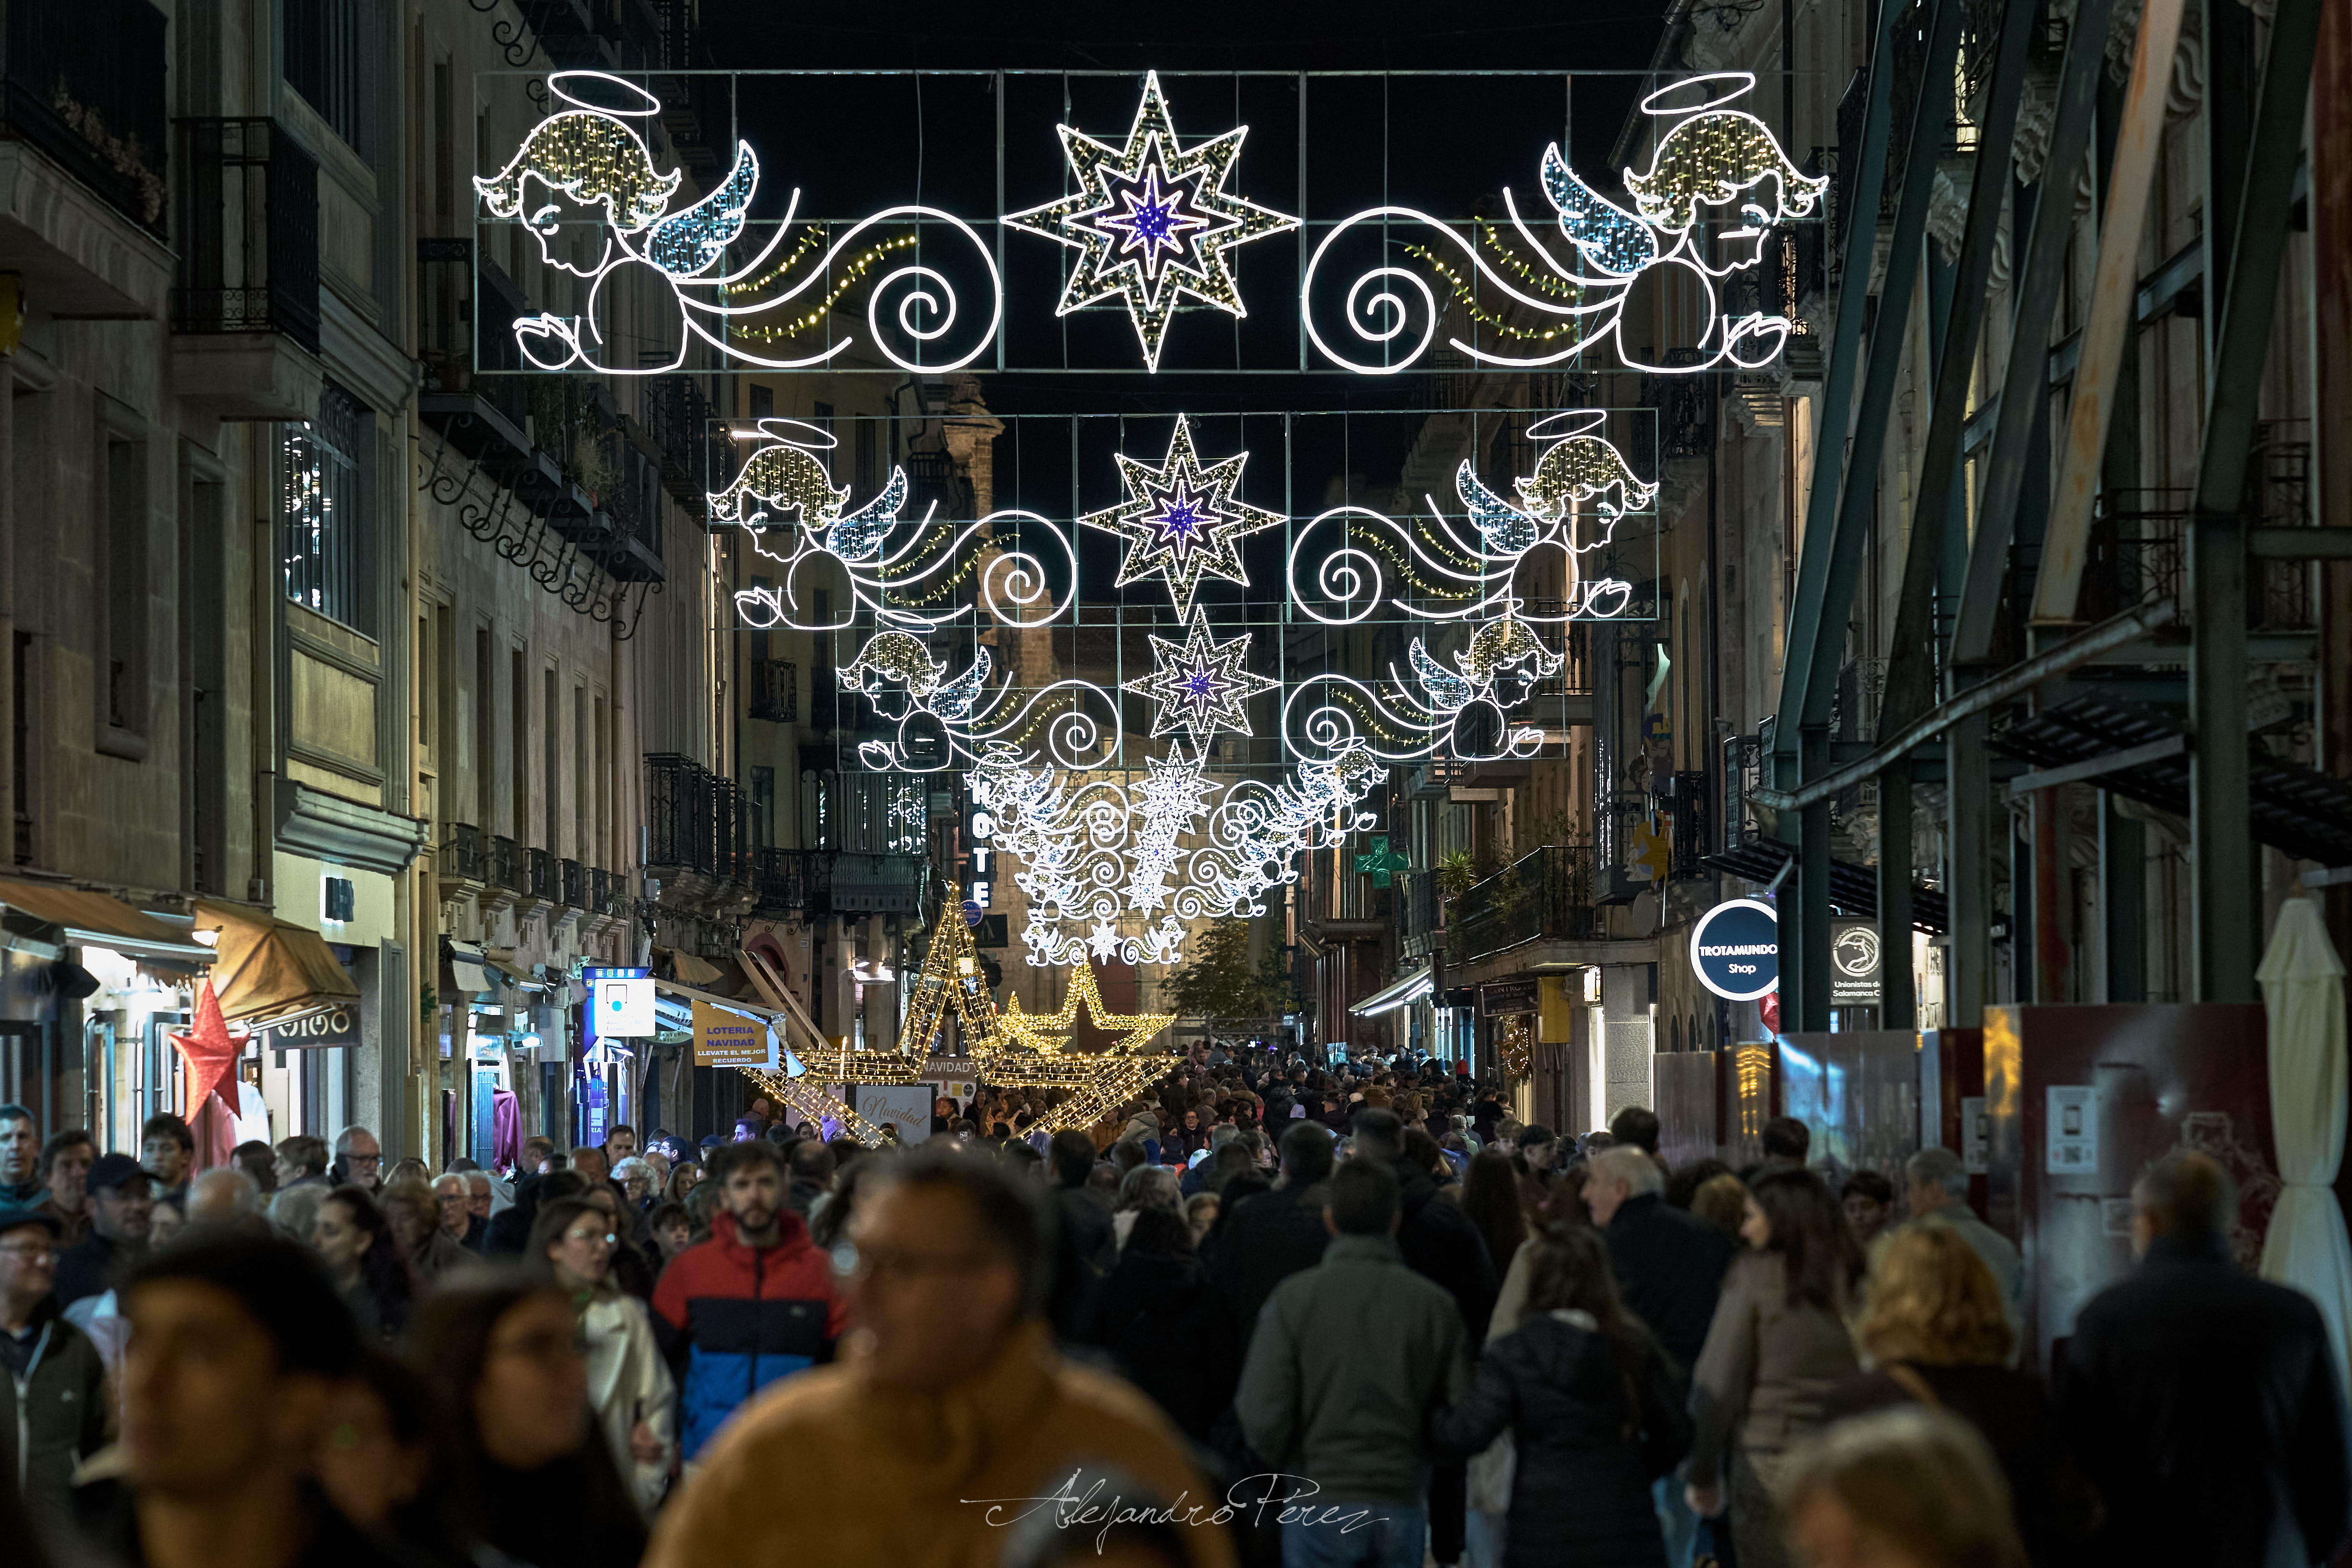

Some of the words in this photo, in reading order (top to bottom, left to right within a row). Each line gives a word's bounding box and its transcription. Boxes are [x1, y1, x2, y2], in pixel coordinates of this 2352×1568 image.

[1699, 944, 1778, 956] TROTAMUNDO
[1729, 963, 1757, 975] Shop
[923, 1062, 970, 1072] NAVIDAD
[862, 1096, 927, 1128] Navidad
